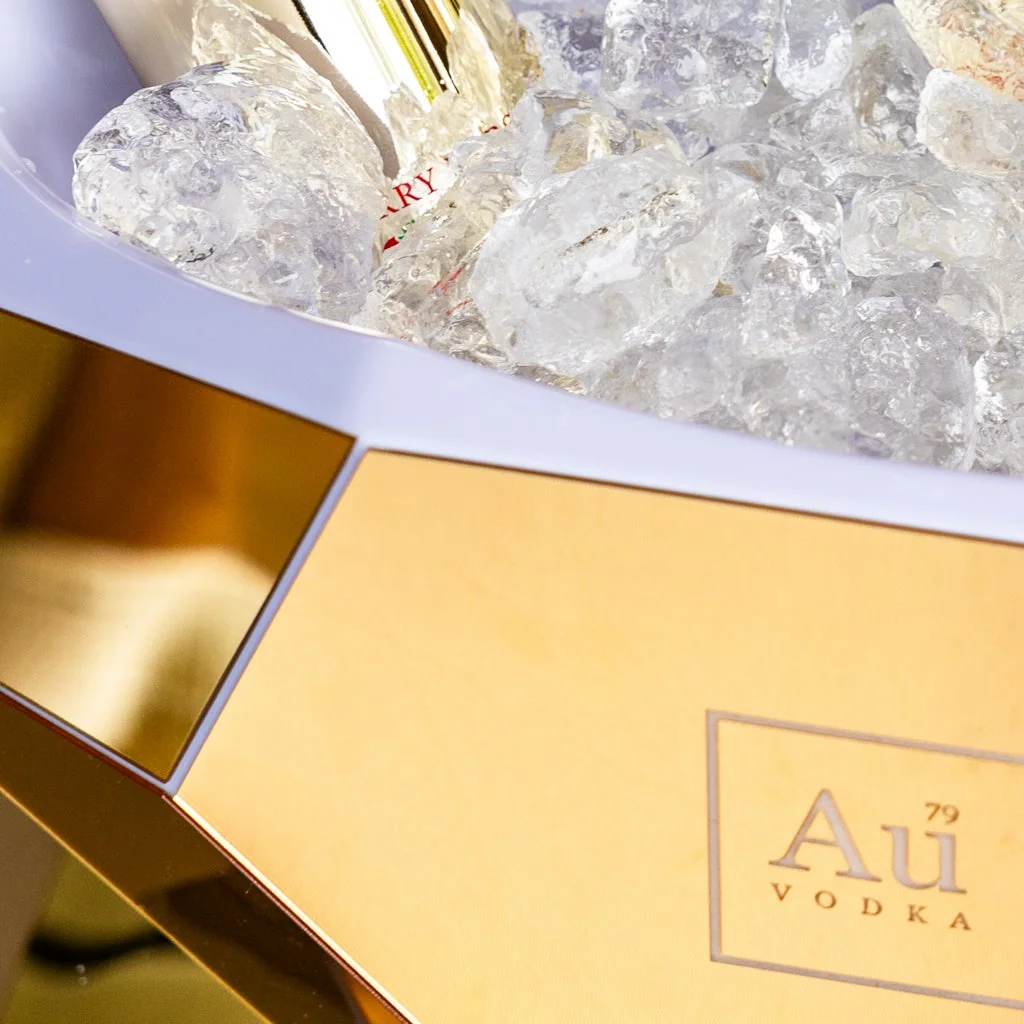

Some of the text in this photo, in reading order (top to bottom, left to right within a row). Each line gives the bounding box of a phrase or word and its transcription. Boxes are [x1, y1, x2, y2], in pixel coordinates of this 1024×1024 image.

[768, 788, 968, 895] Au 79
[771, 882, 972, 932] VODKA
